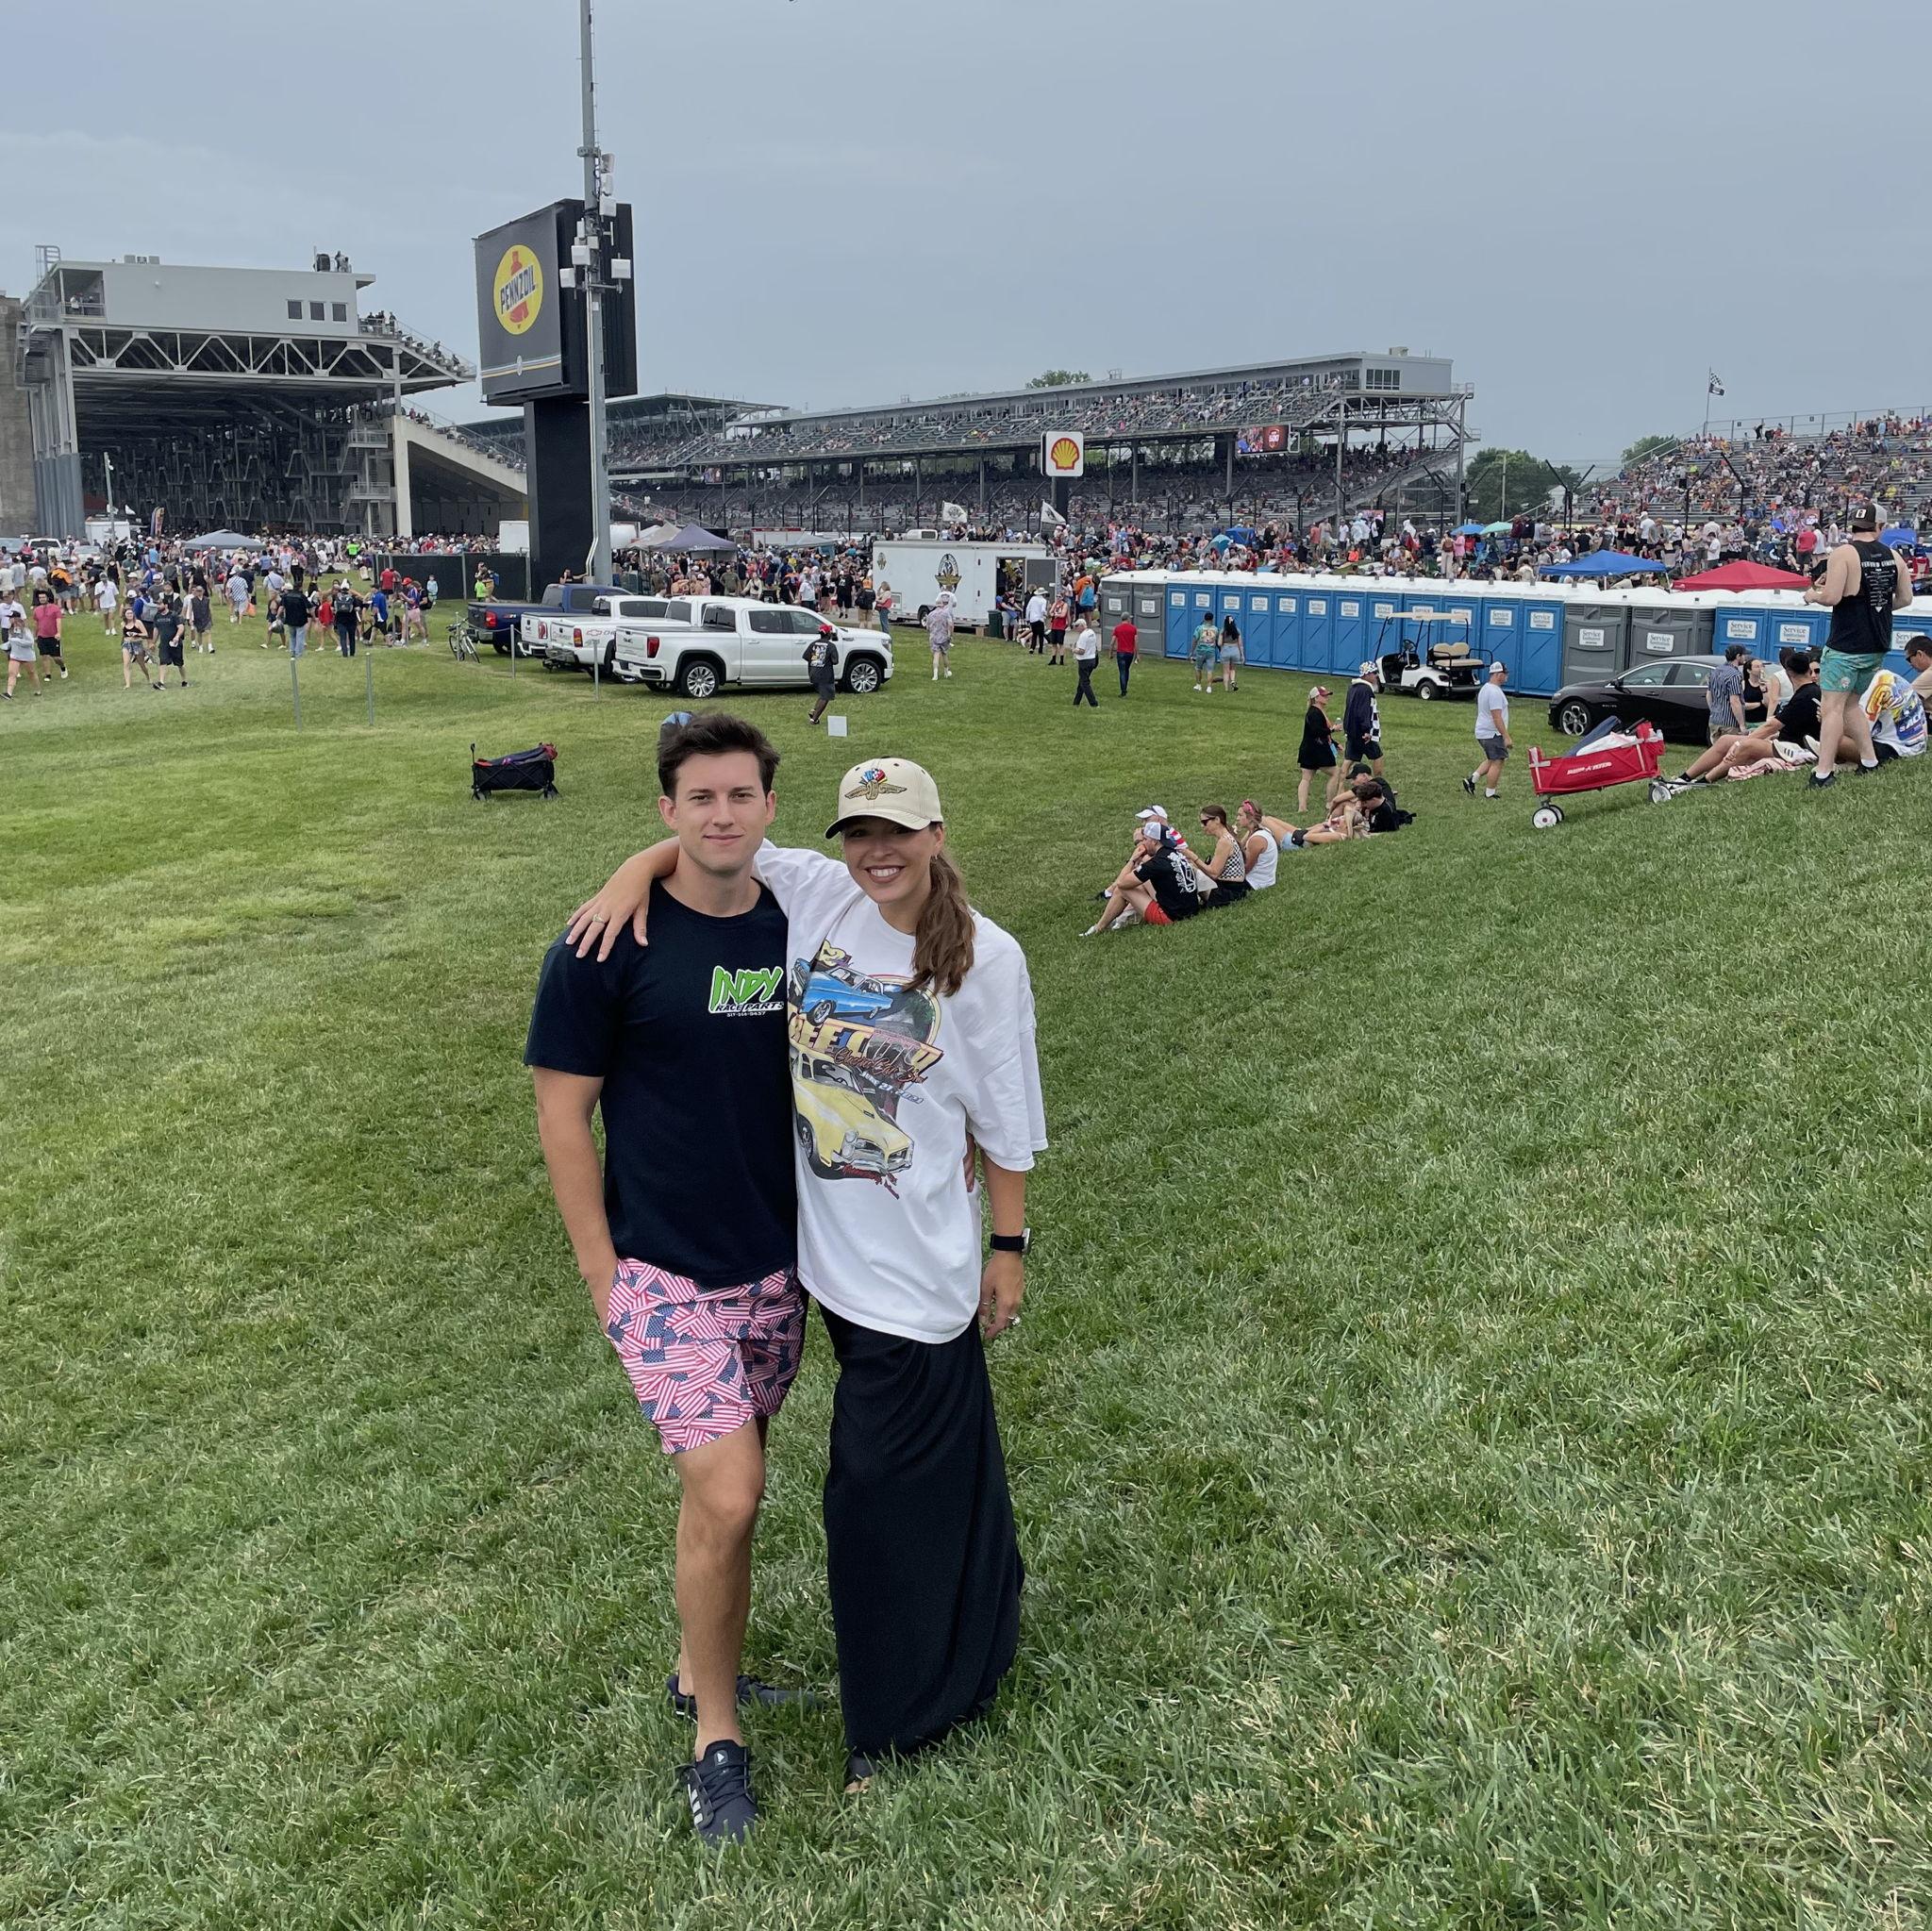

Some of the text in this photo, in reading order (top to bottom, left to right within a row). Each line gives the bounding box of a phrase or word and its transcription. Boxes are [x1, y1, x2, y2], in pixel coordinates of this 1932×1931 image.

[500, 265, 536, 315] PENNZOIL
[1730, 621, 1753, 629] Service
[1784, 625, 1807, 634] Service
[1650, 633, 1671, 642] Service
[708, 965, 784, 1013] INDY
[716, 1001, 785, 1012] RACE PARTS
